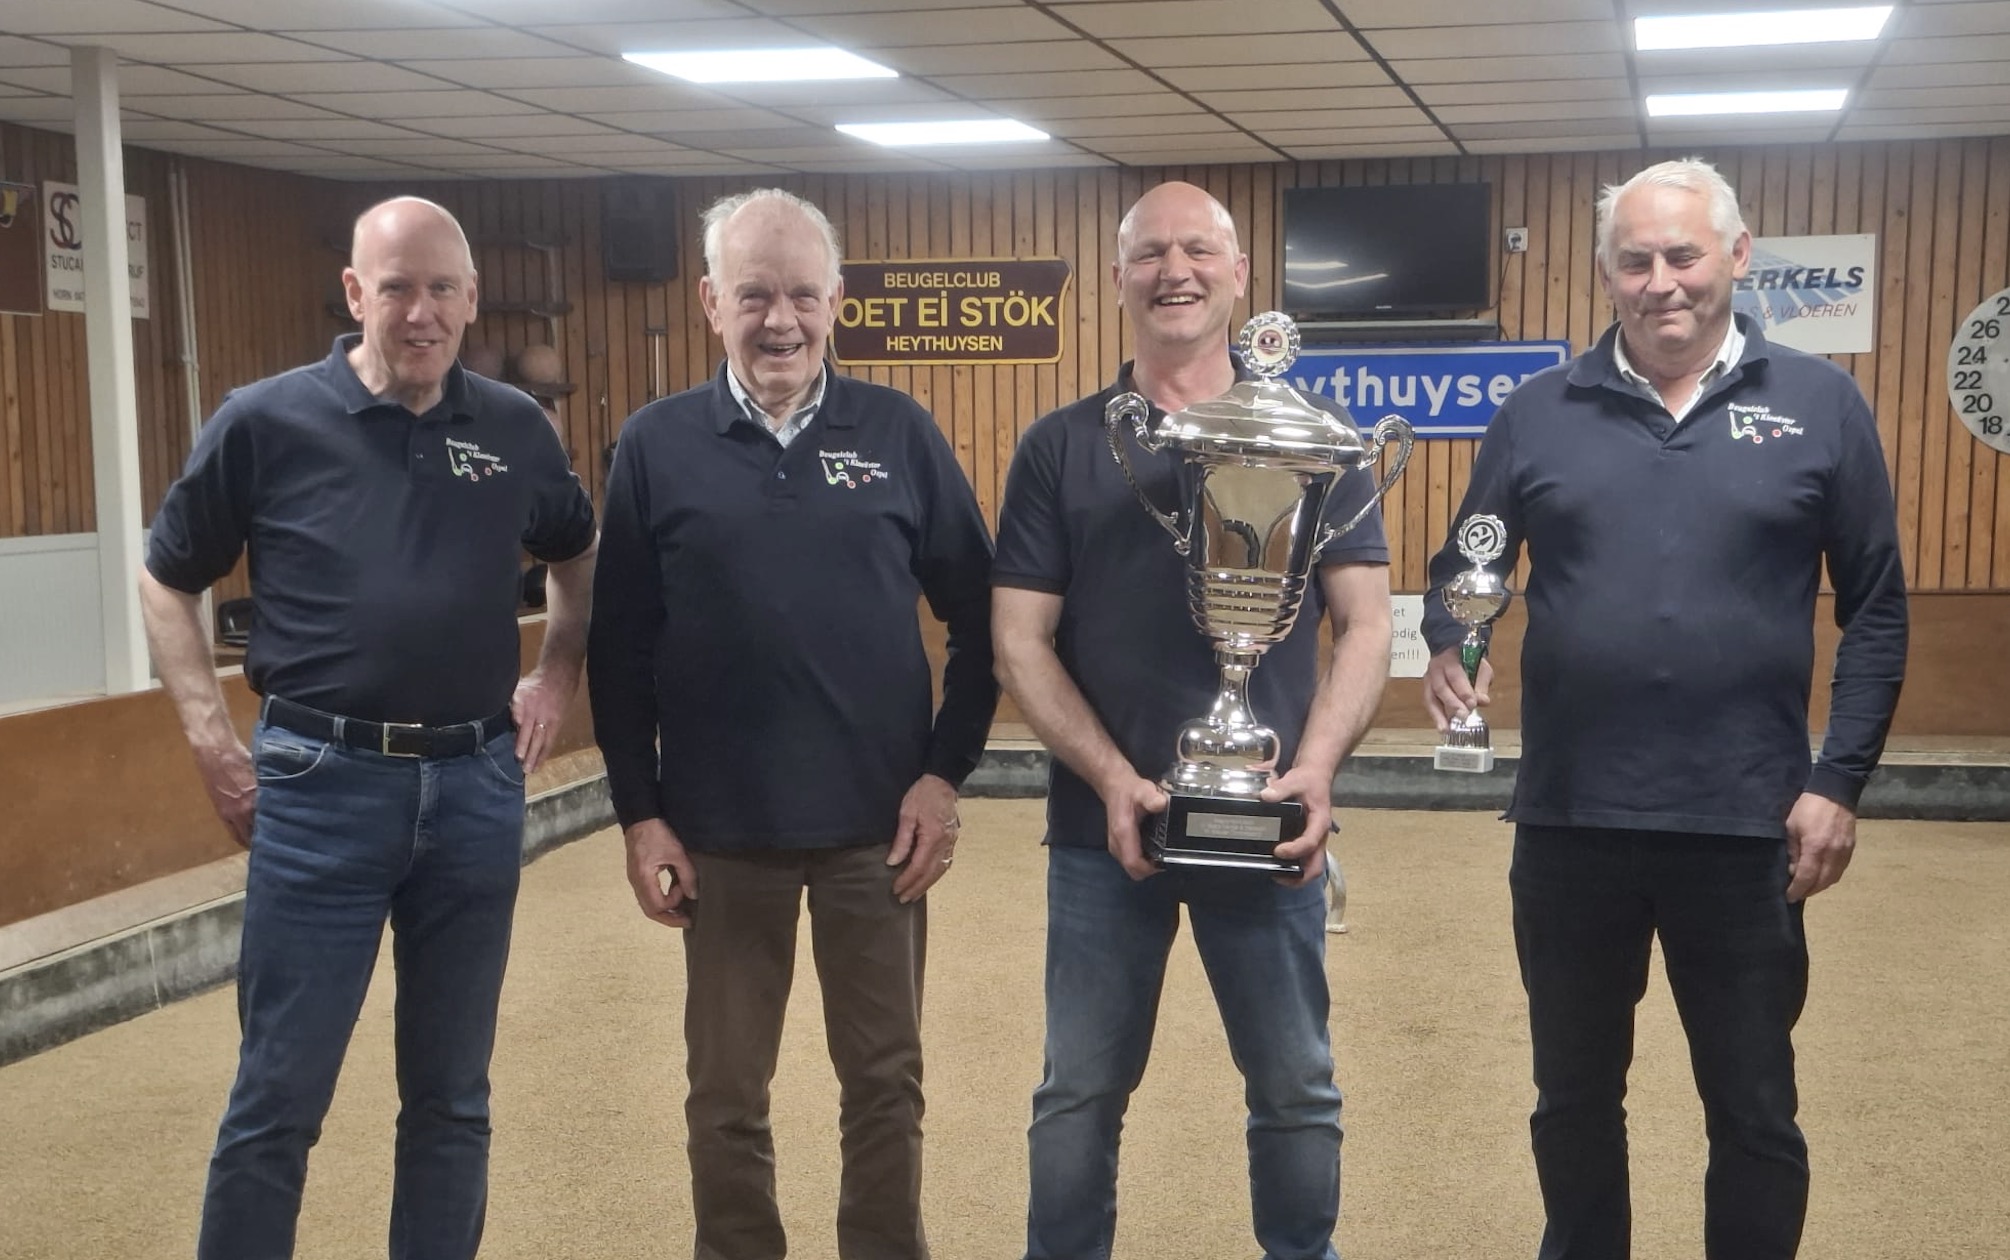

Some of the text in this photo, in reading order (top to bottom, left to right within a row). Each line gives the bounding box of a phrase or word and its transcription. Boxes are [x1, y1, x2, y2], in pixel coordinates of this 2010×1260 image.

[884, 272, 1001, 289] BEUGELCLUB
[838, 297, 908, 328] OET
[960, 289, 1055, 327] STÖK
[1781, 303, 1858, 319] VLOEREN
[1971, 319, 2000, 339] 26
[886, 335, 1003, 351] HEYTHUYSEN
[1957, 346, 1987, 366] 24
[1954, 371, 1982, 390] 22
[1275, 366, 1532, 416] ythuyse
[1962, 393, 1993, 413] 20
[1978, 415, 2003, 435] 18
[1391, 648, 1420, 660] en!!!
